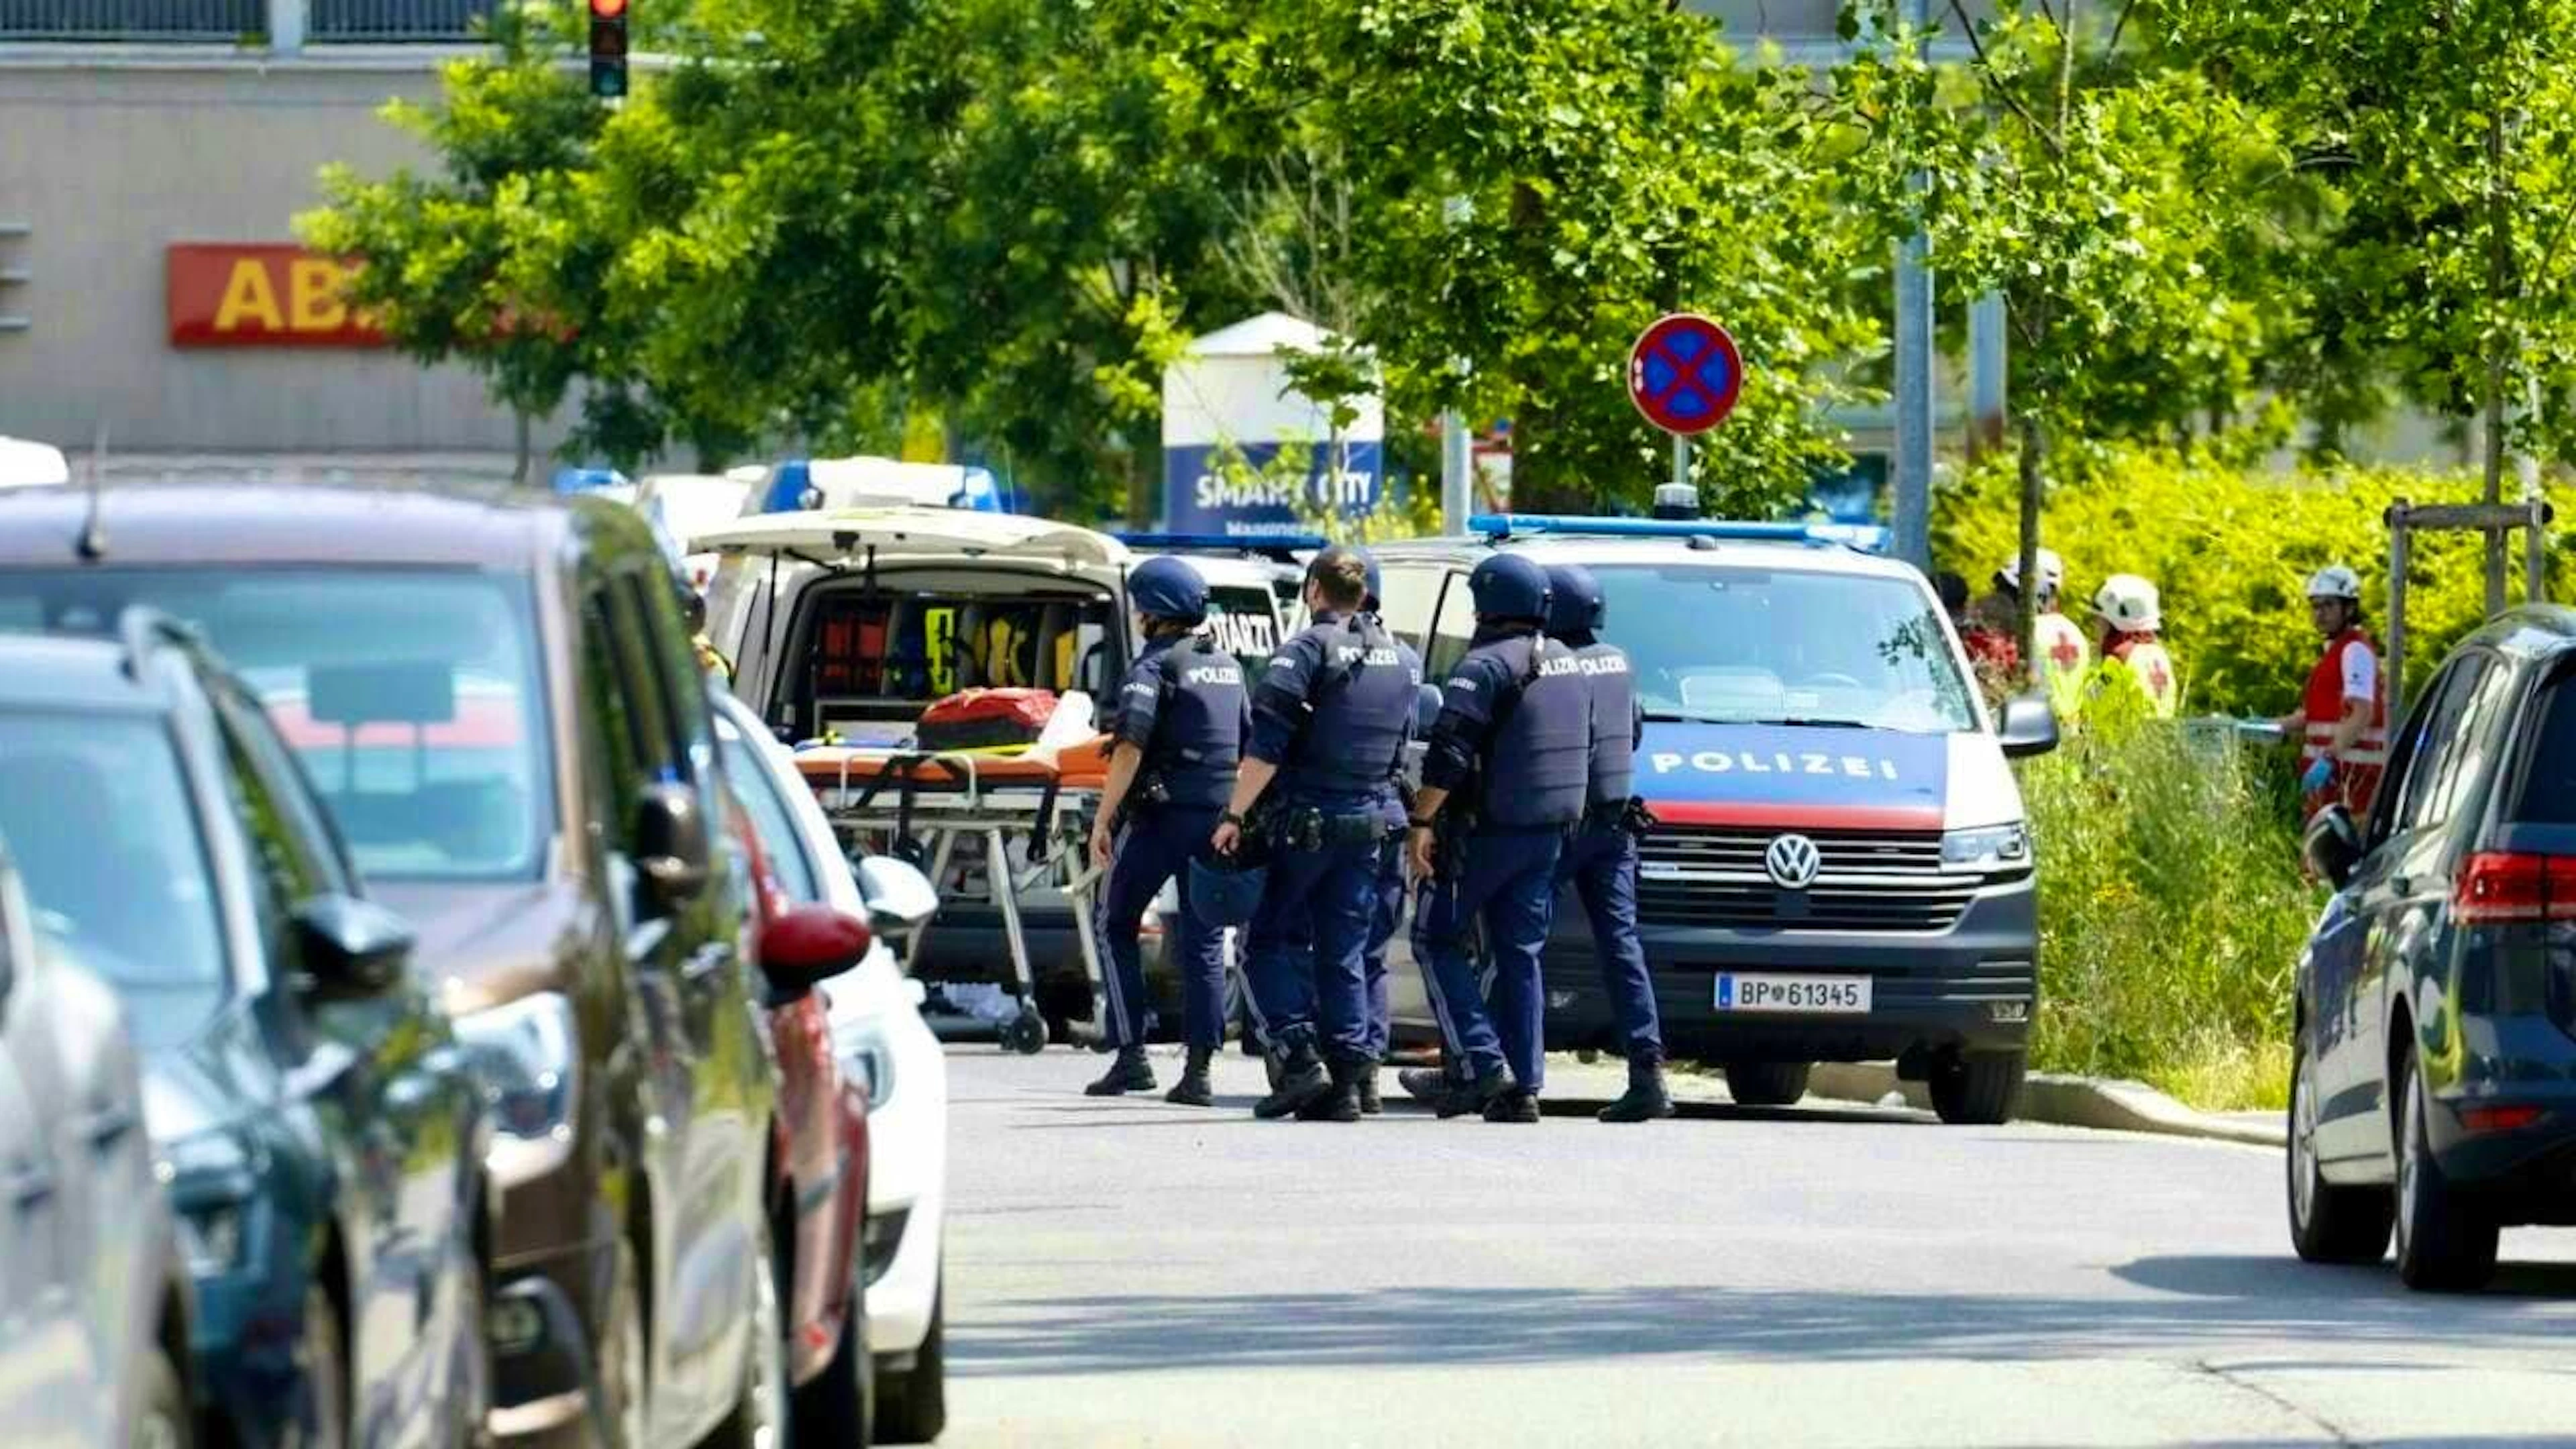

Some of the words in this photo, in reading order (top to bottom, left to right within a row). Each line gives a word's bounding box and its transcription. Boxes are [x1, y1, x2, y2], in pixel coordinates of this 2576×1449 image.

[1651, 751, 1898, 780] POLIZEI
[1741, 982, 1770, 1004] BP
[1788, 983, 1858, 1006] 61345
